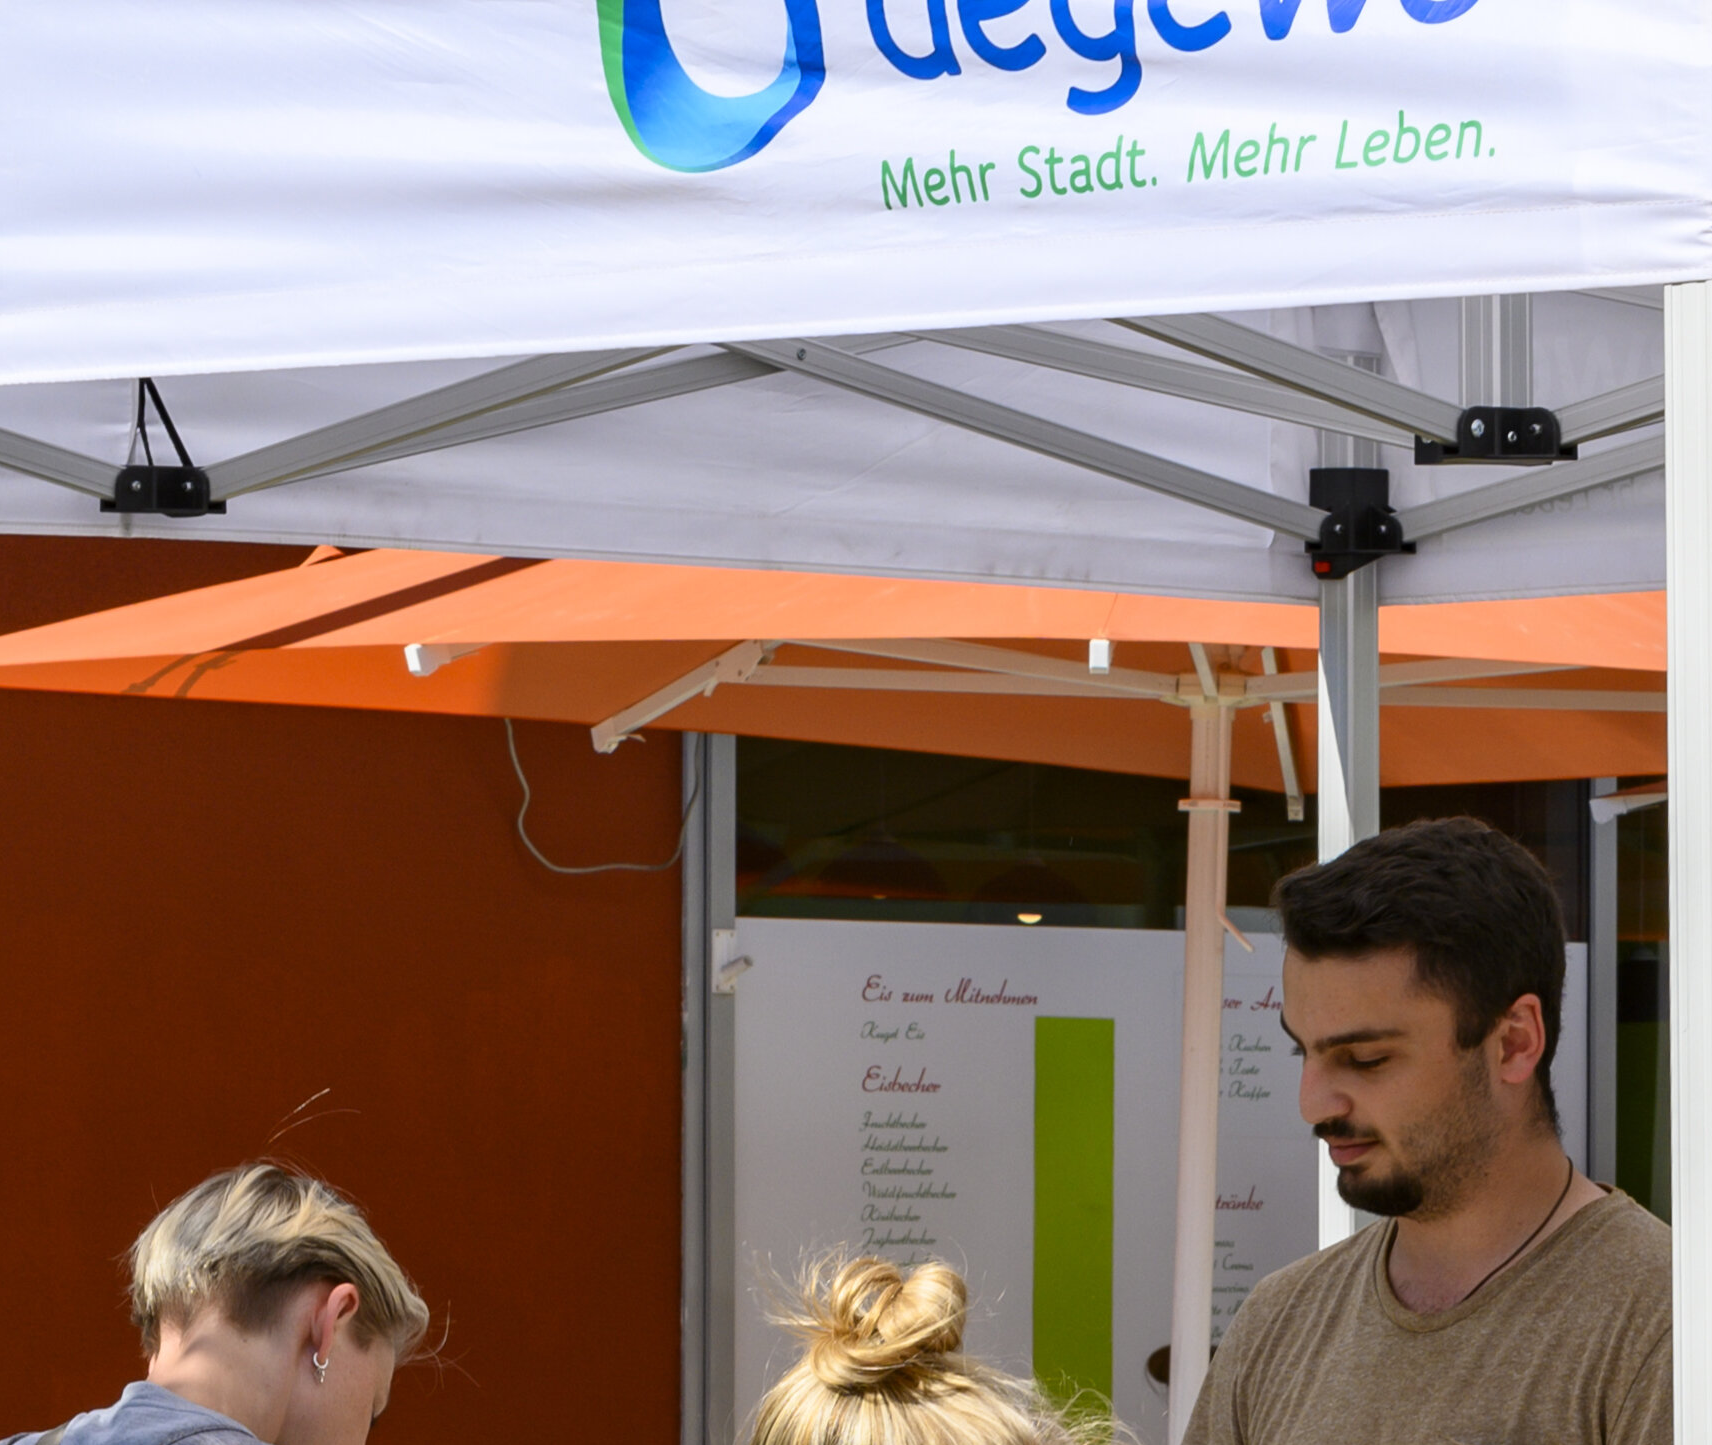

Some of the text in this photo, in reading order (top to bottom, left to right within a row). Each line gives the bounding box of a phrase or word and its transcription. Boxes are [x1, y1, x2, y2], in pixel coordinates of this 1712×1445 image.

[881, 109, 1497, 211] Mehr Stadt. Mehr Leben.
[862, 974, 1039, 1006] Eis zum Mitnehmen
[862, 1065, 942, 1094] Eisbecher
[1215, 1184, 1264, 1211] tränke
